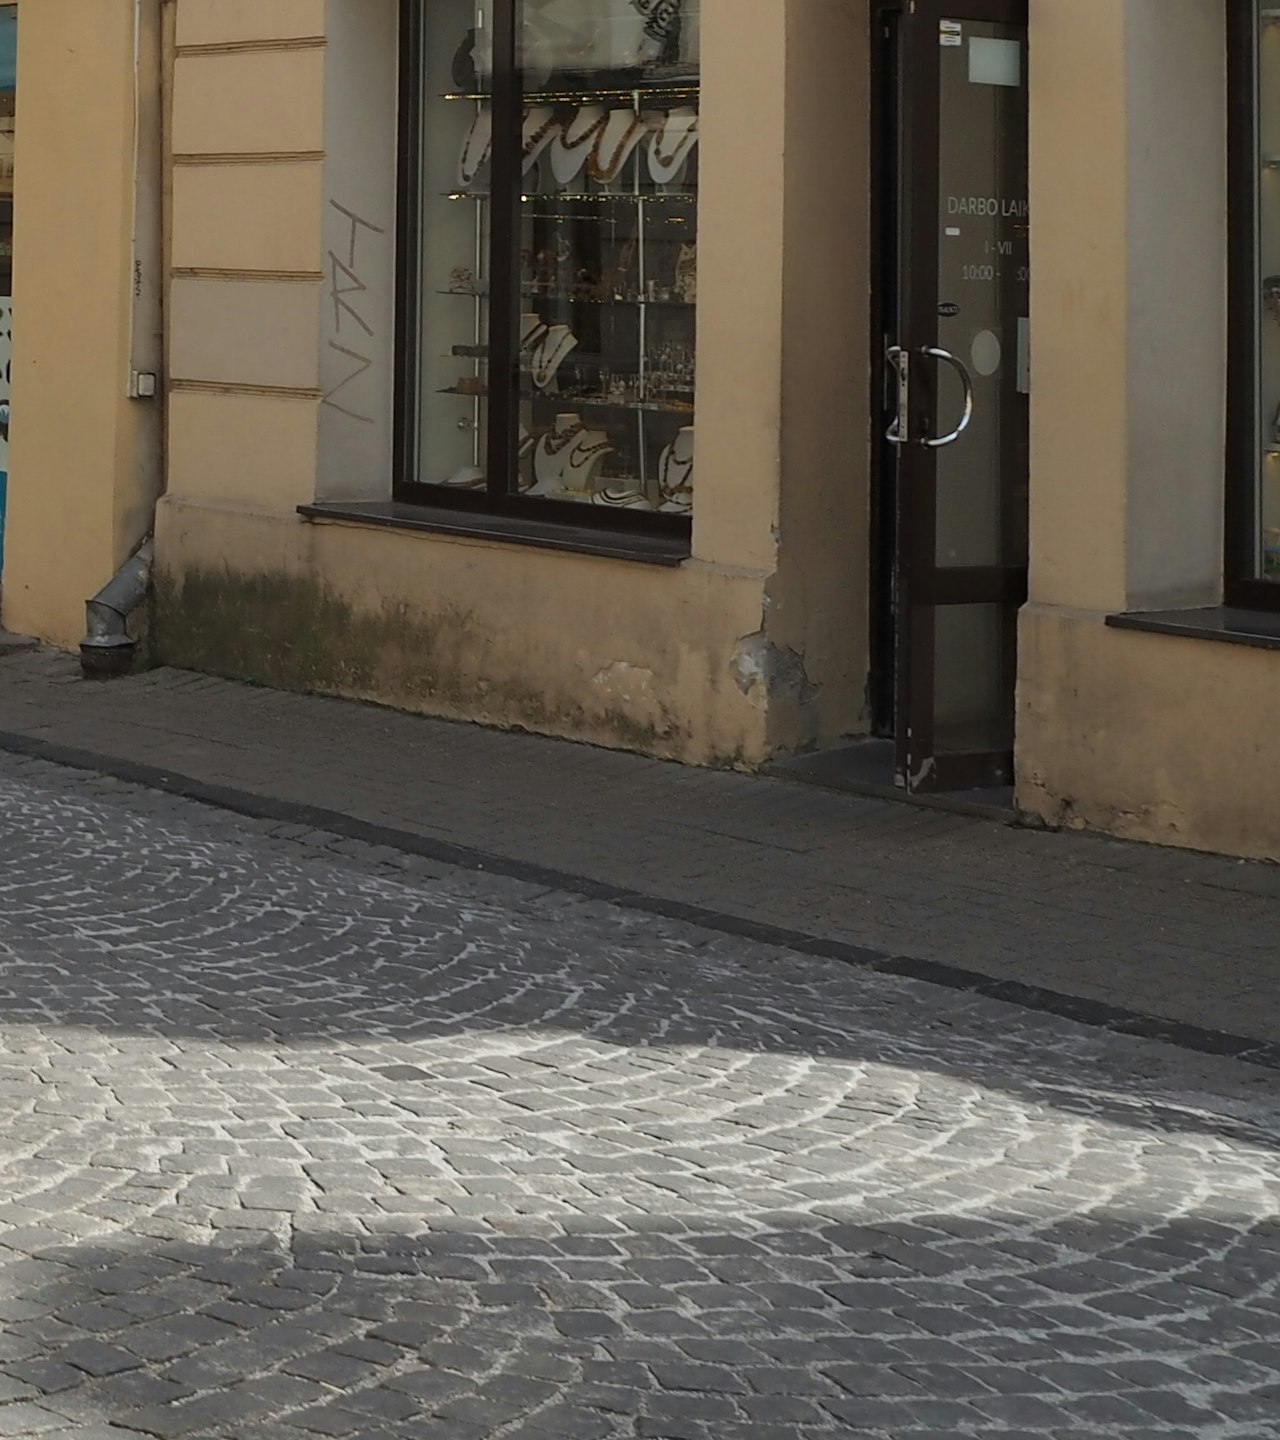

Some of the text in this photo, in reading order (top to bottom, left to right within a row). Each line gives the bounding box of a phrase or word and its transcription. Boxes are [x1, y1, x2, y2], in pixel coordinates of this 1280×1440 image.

[947, 197, 1028, 217] DARBO LAIK
[998, 241, 1012, 255] VII
[962, 266, 993, 280] 10:00
